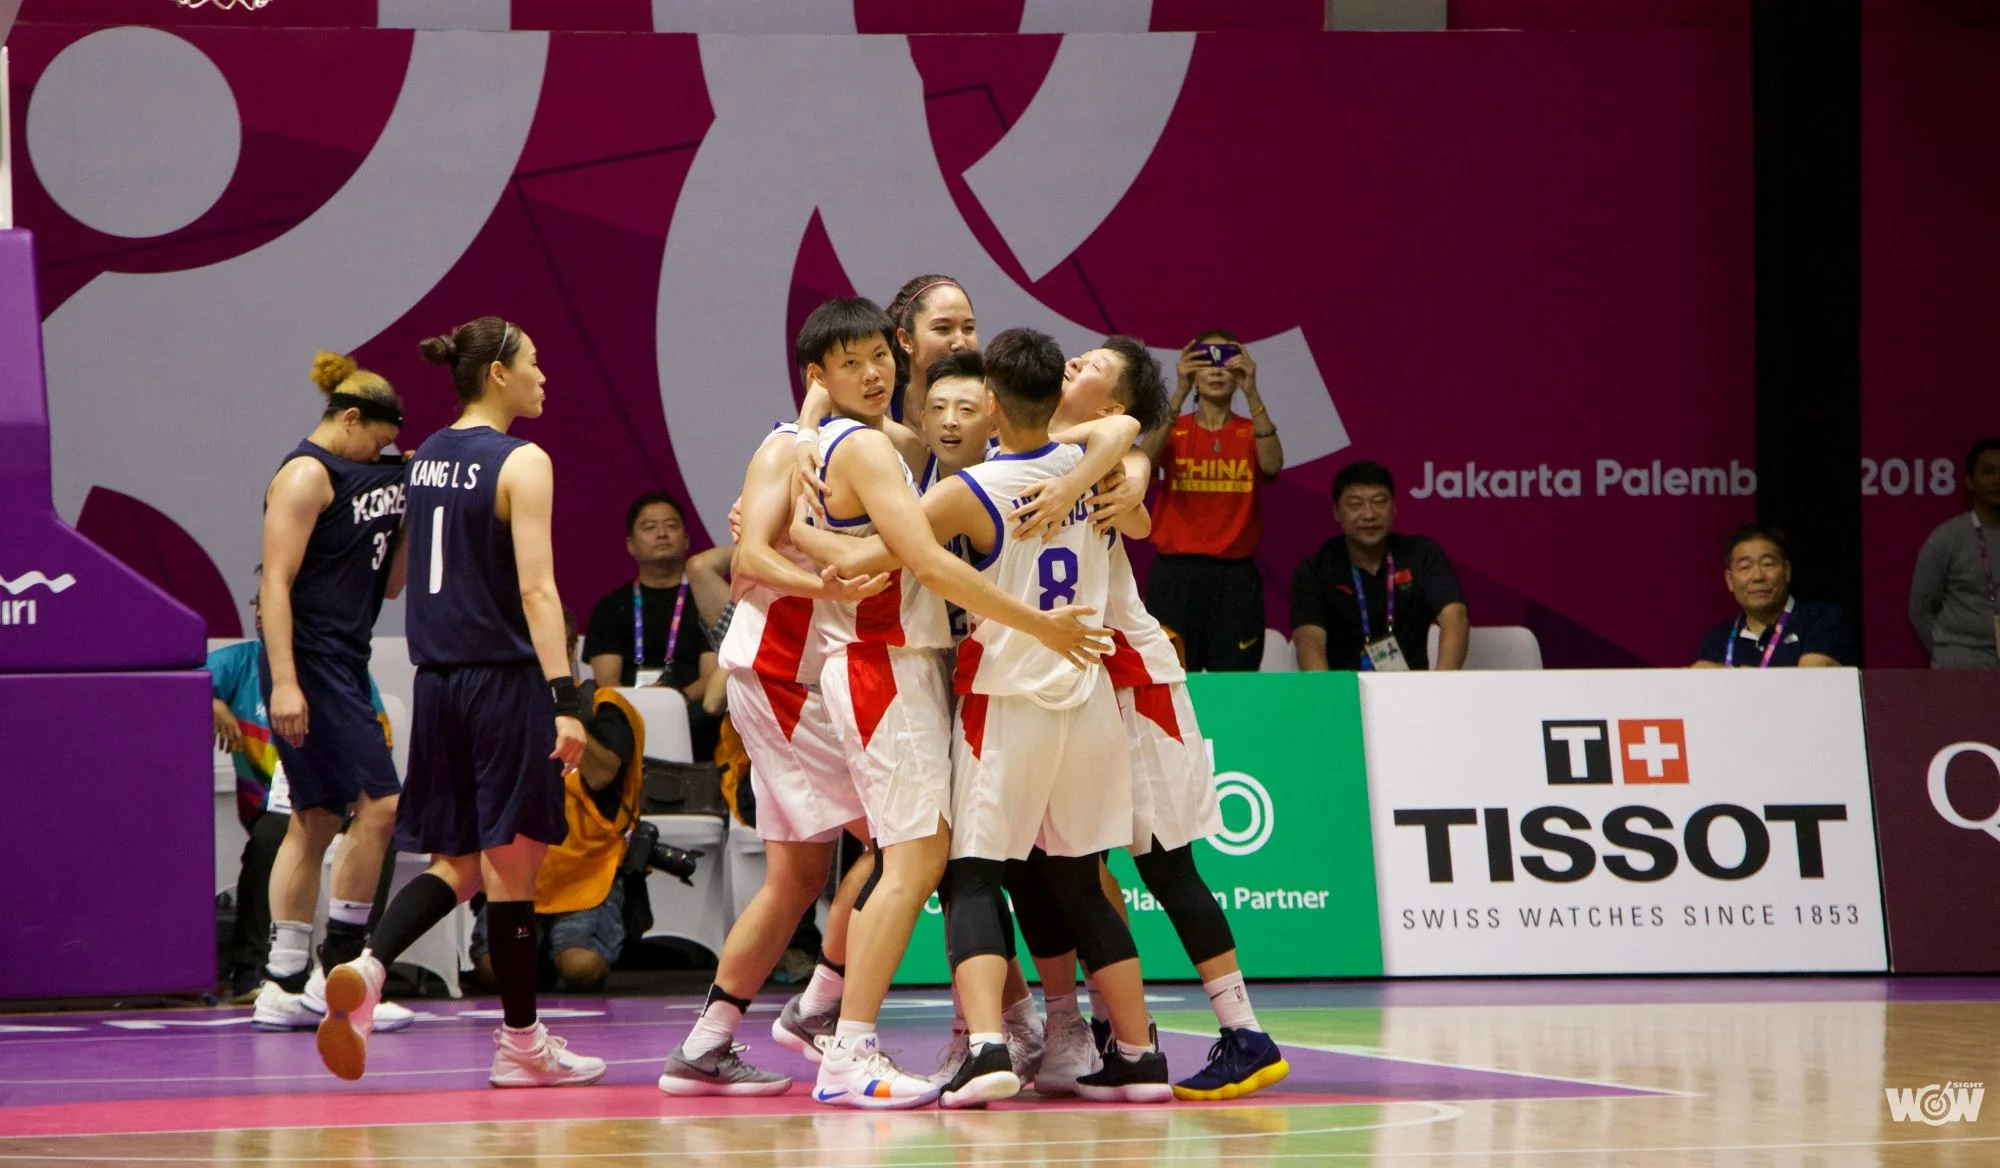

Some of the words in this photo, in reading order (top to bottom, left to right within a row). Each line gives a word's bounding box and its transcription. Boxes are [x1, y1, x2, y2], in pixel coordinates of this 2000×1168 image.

[410, 459, 450, 488] KANG
[1174, 457, 1254, 480] CHINA
[1408, 460, 1582, 499] Jakarta
[1596, 458, 1758, 496] Palemb
[1860, 457, 1956, 496] 2018
[351, 482, 407, 525] KORE
[371, 529, 392, 571] 3
[429, 505, 445, 594] 1
[1037, 546, 1079, 612] 8
[1393, 803, 1848, 884] TISSOT
[1233, 886, 1330, 911] Partner
[1402, 907, 1500, 930] SWISS
[1518, 906, 1665, 929] WATCHES
[1683, 904, 1776, 928] SINCE
[1794, 903, 1859, 926] 1853
